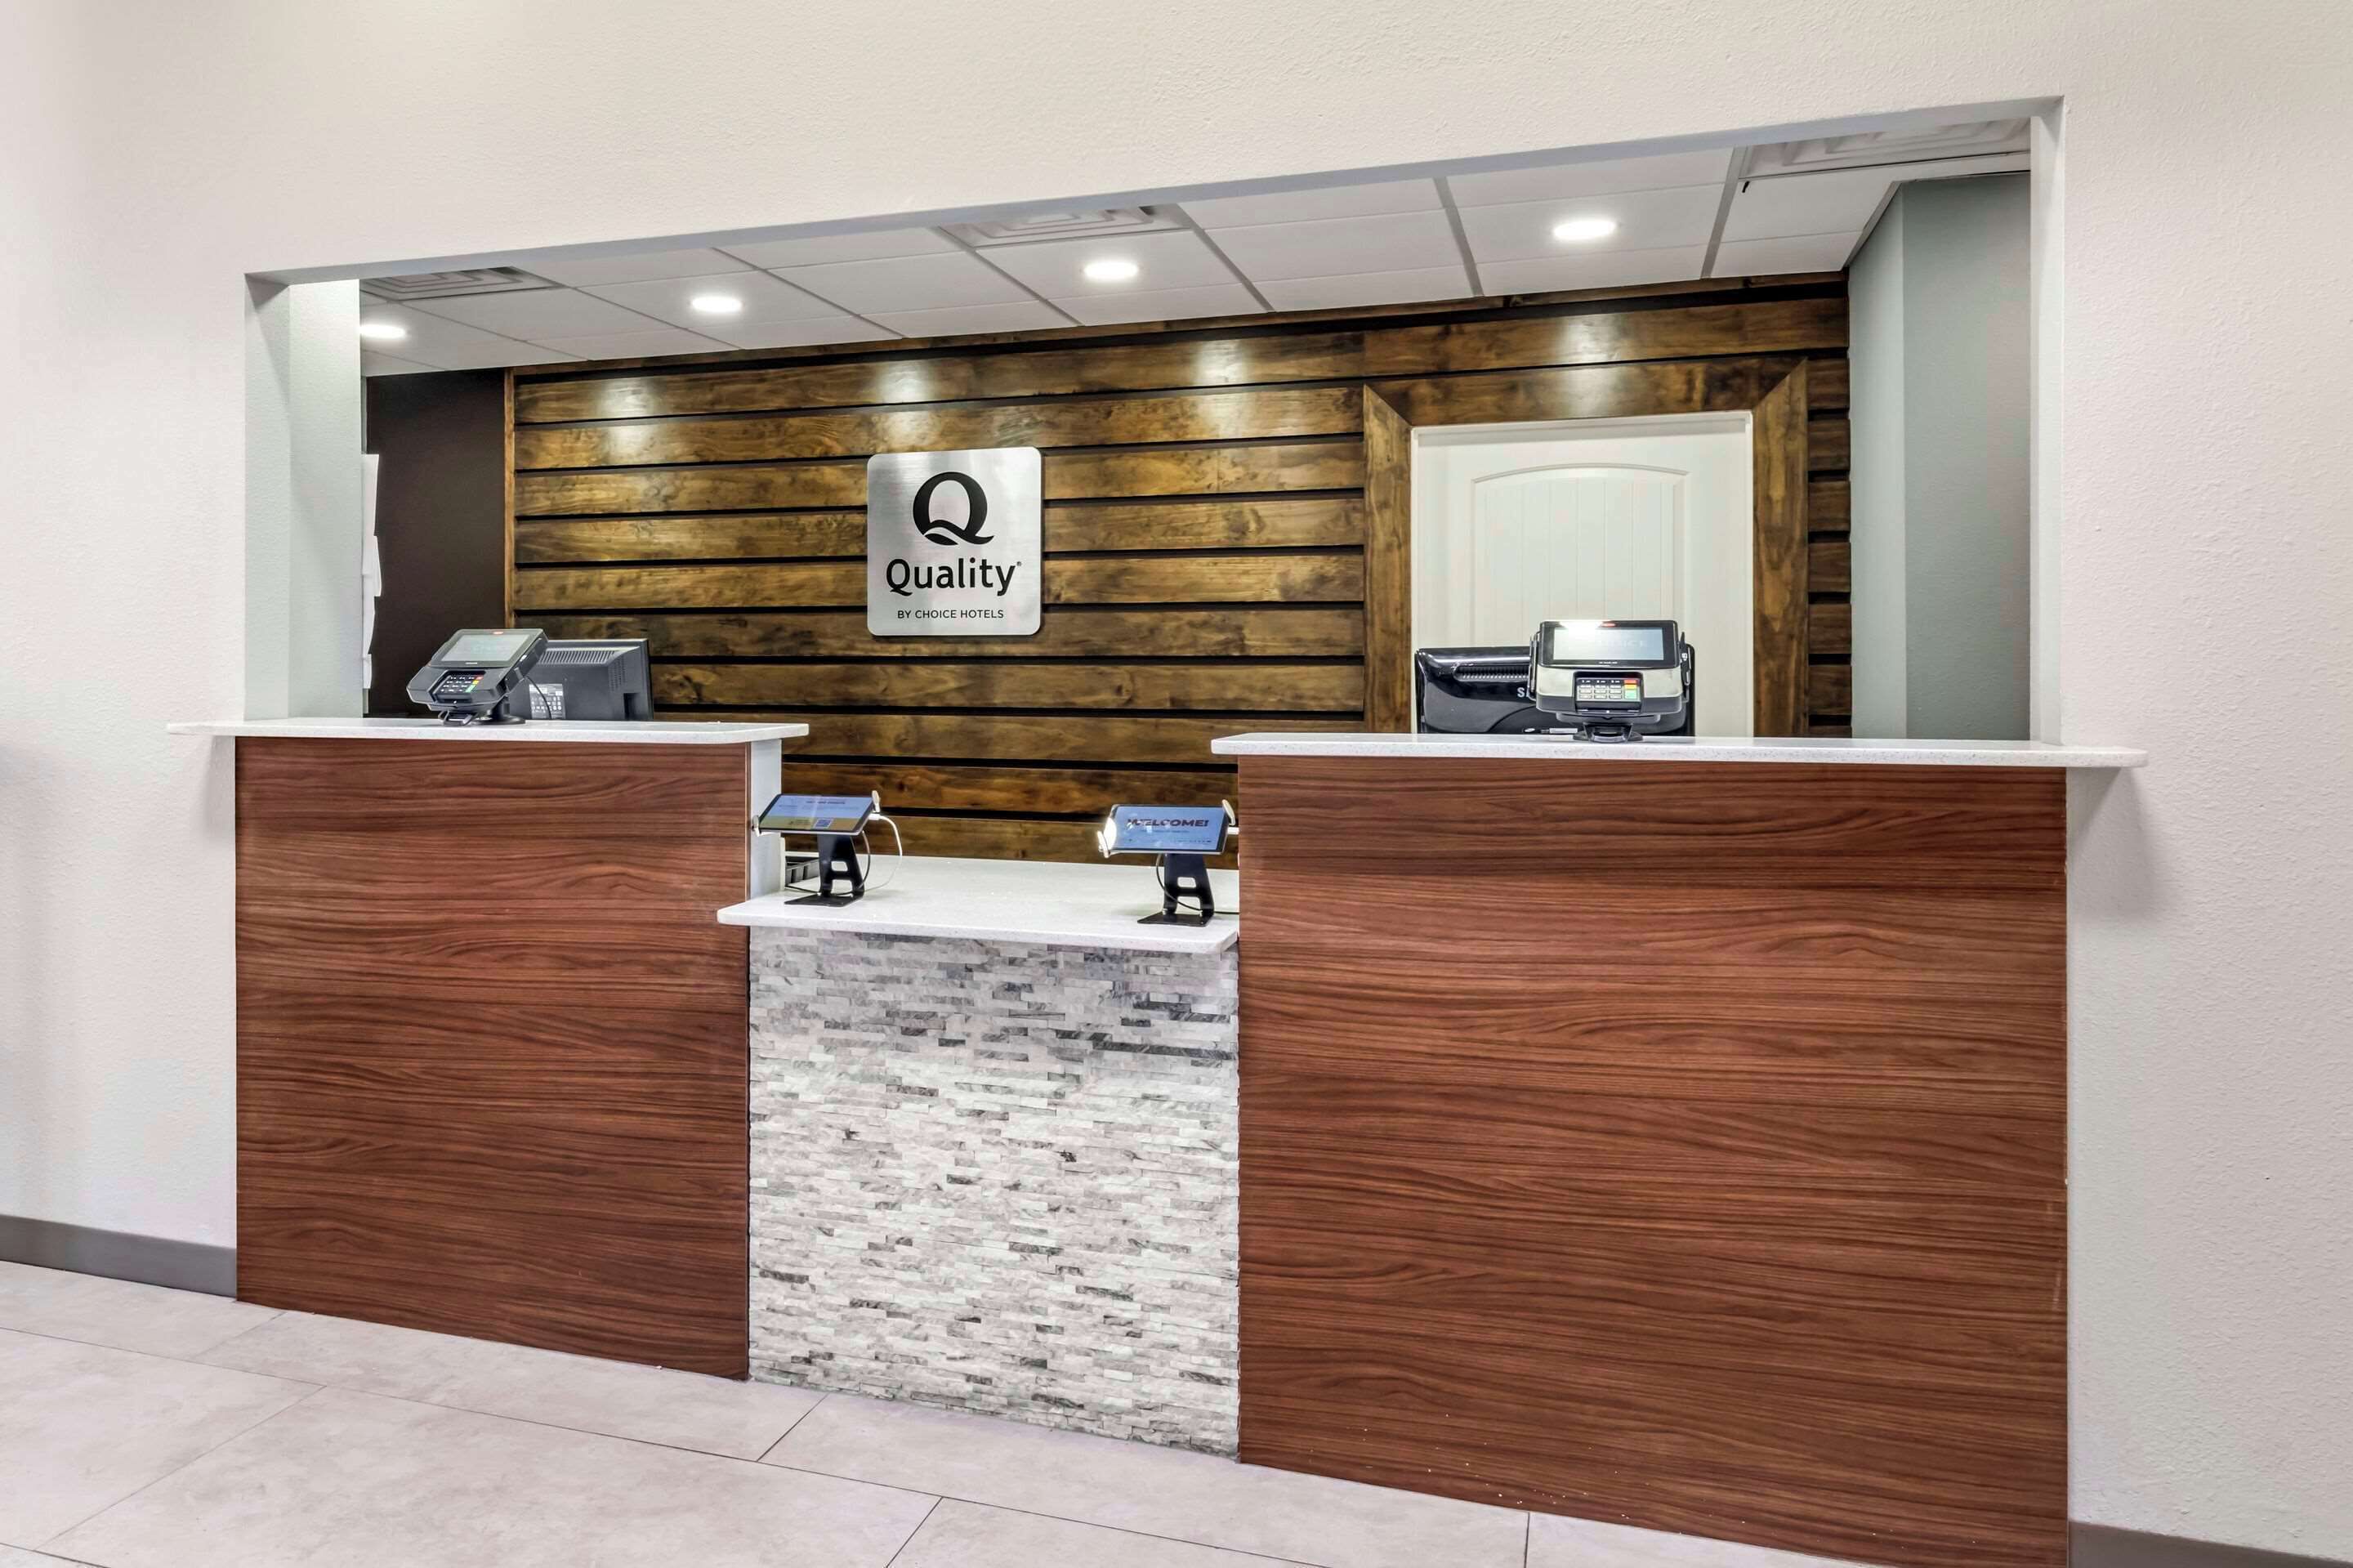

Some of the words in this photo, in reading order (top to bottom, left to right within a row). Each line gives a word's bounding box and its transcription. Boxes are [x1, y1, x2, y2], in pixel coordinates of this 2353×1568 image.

[897, 610, 912, 619] BY
[915, 610, 957, 619] CHOICE
[960, 610, 1004, 619] HOTELS
